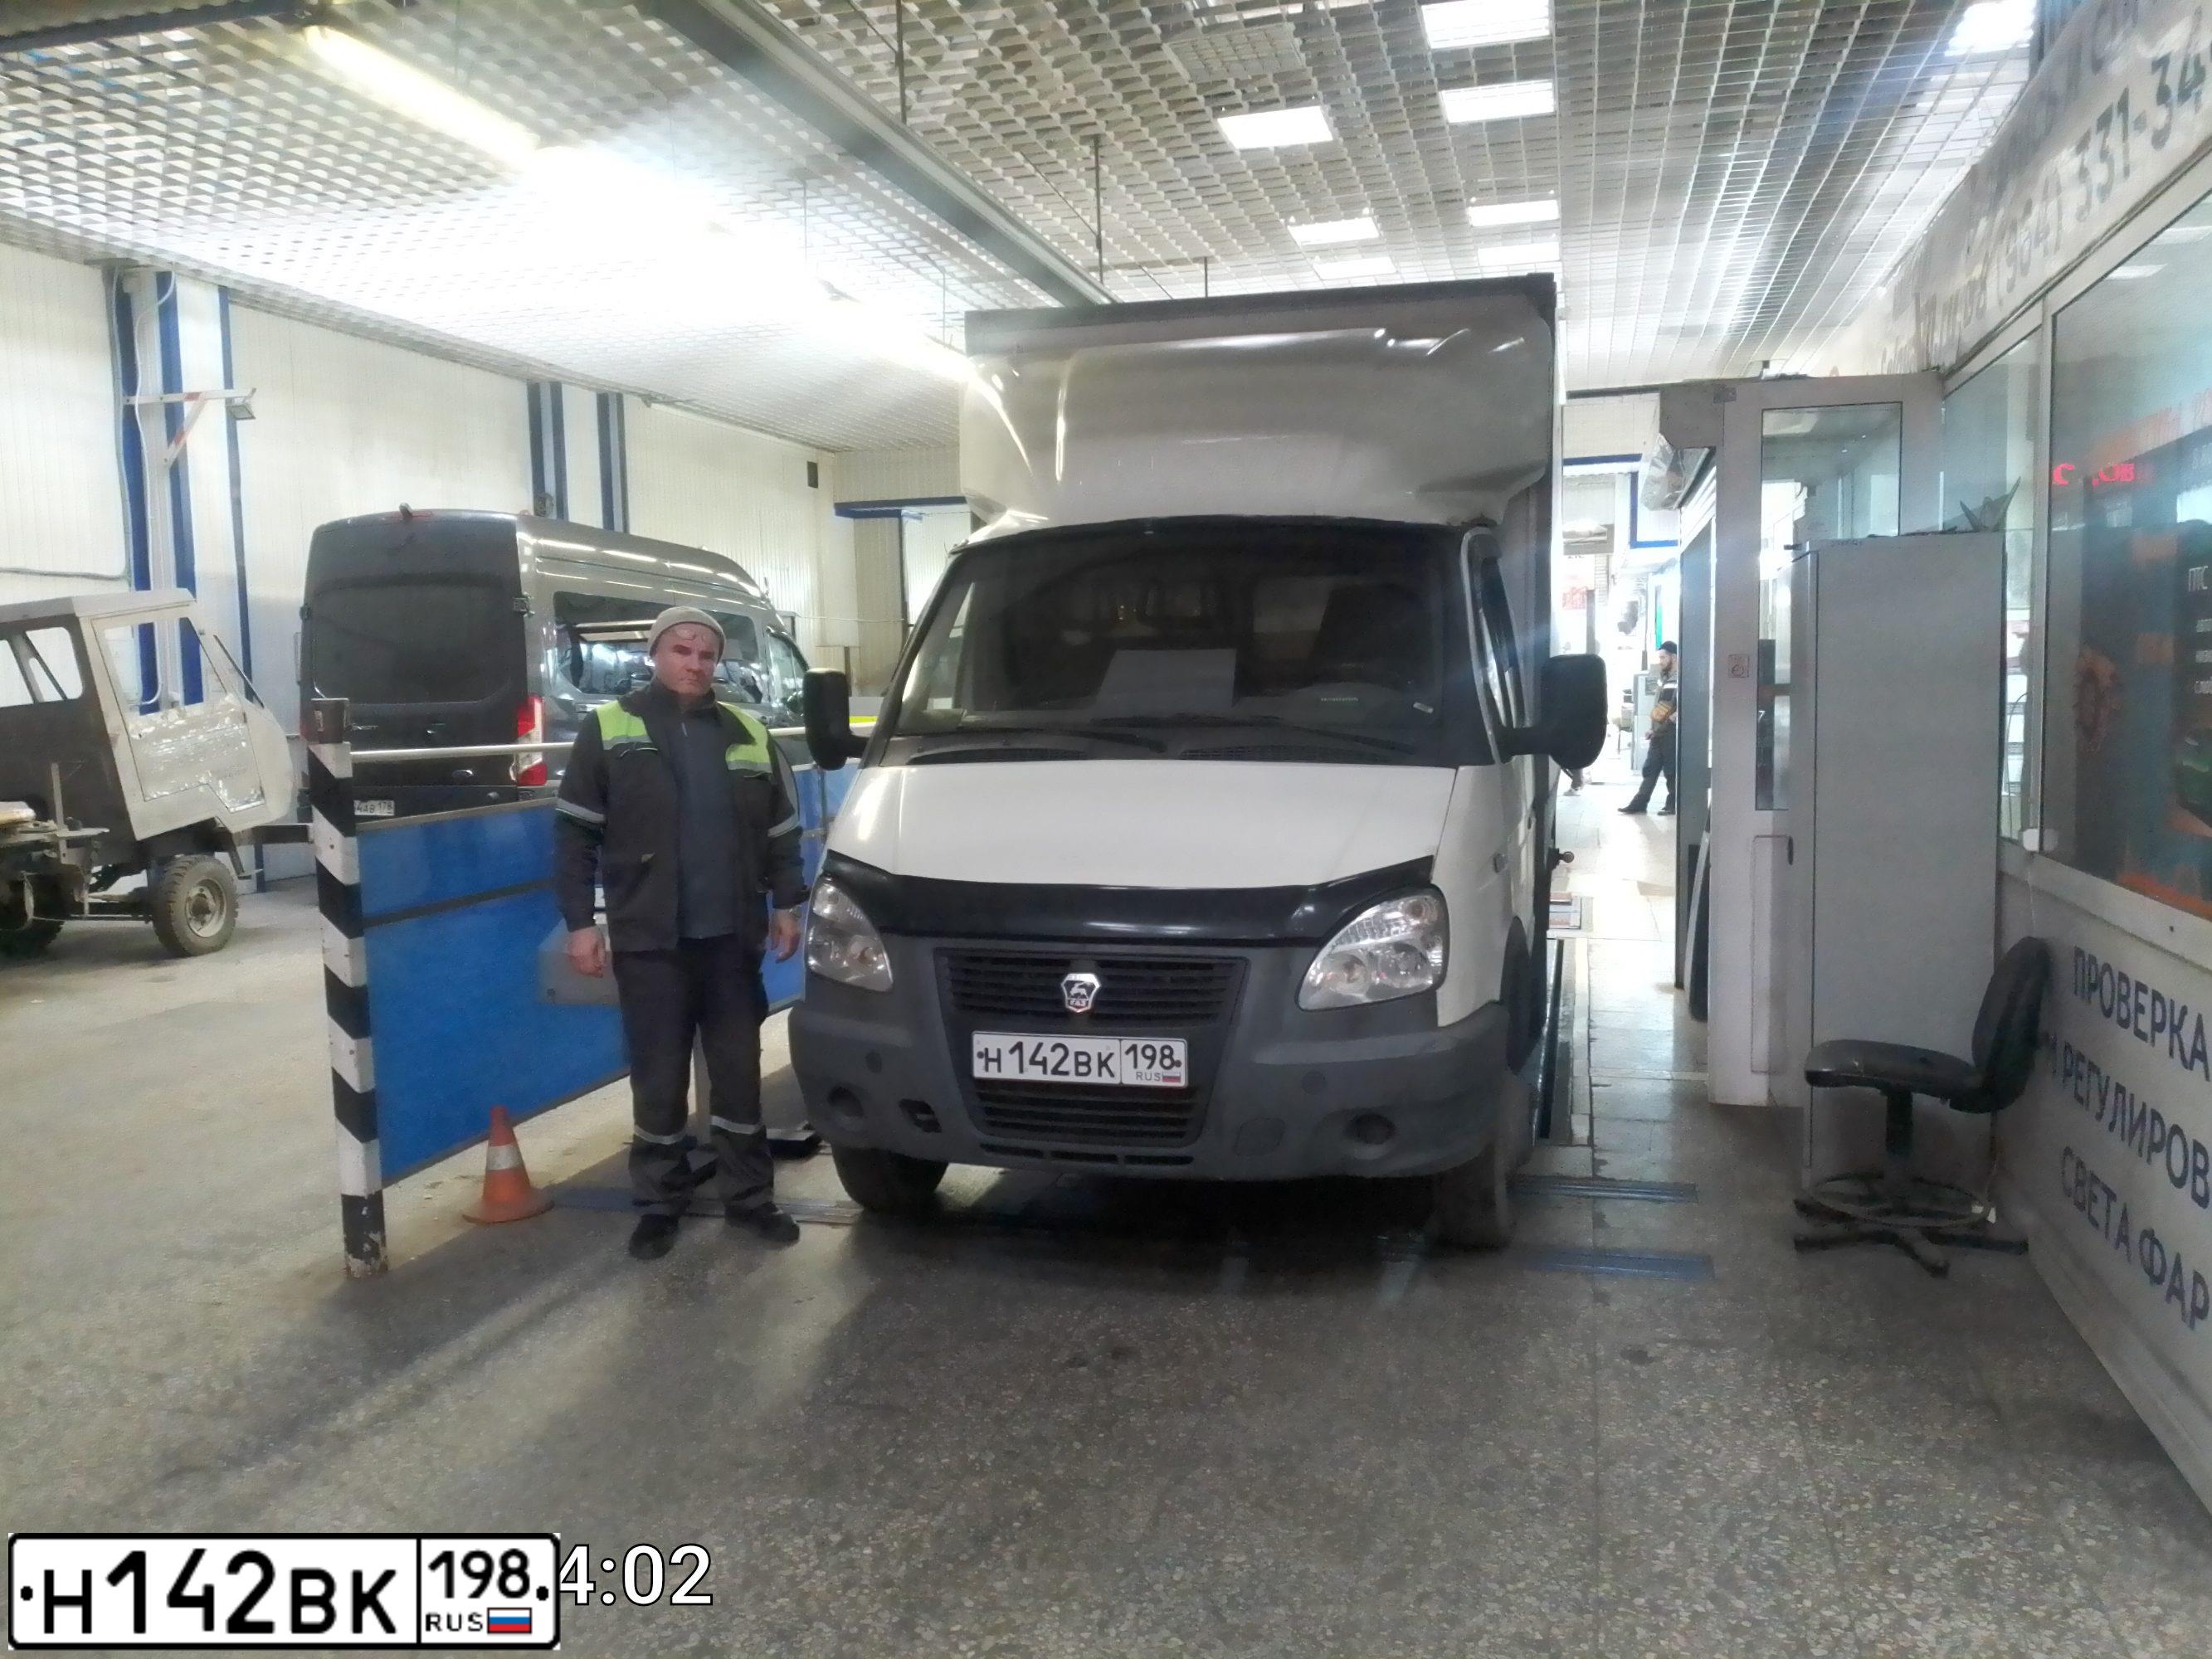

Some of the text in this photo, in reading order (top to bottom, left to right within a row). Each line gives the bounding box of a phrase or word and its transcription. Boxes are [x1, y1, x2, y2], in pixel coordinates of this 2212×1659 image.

[984, 1041, 1175, 1078] Н142ВК 198
[1135, 1071, 1162, 1082] RUS
[2074, 946, 2210, 1082] ПРОВЕРКА
[2063, 1039, 2210, 1209] РЕГУЛИРОВ
[2061, 1146, 2210, 1331] СВЕТА ФАР
